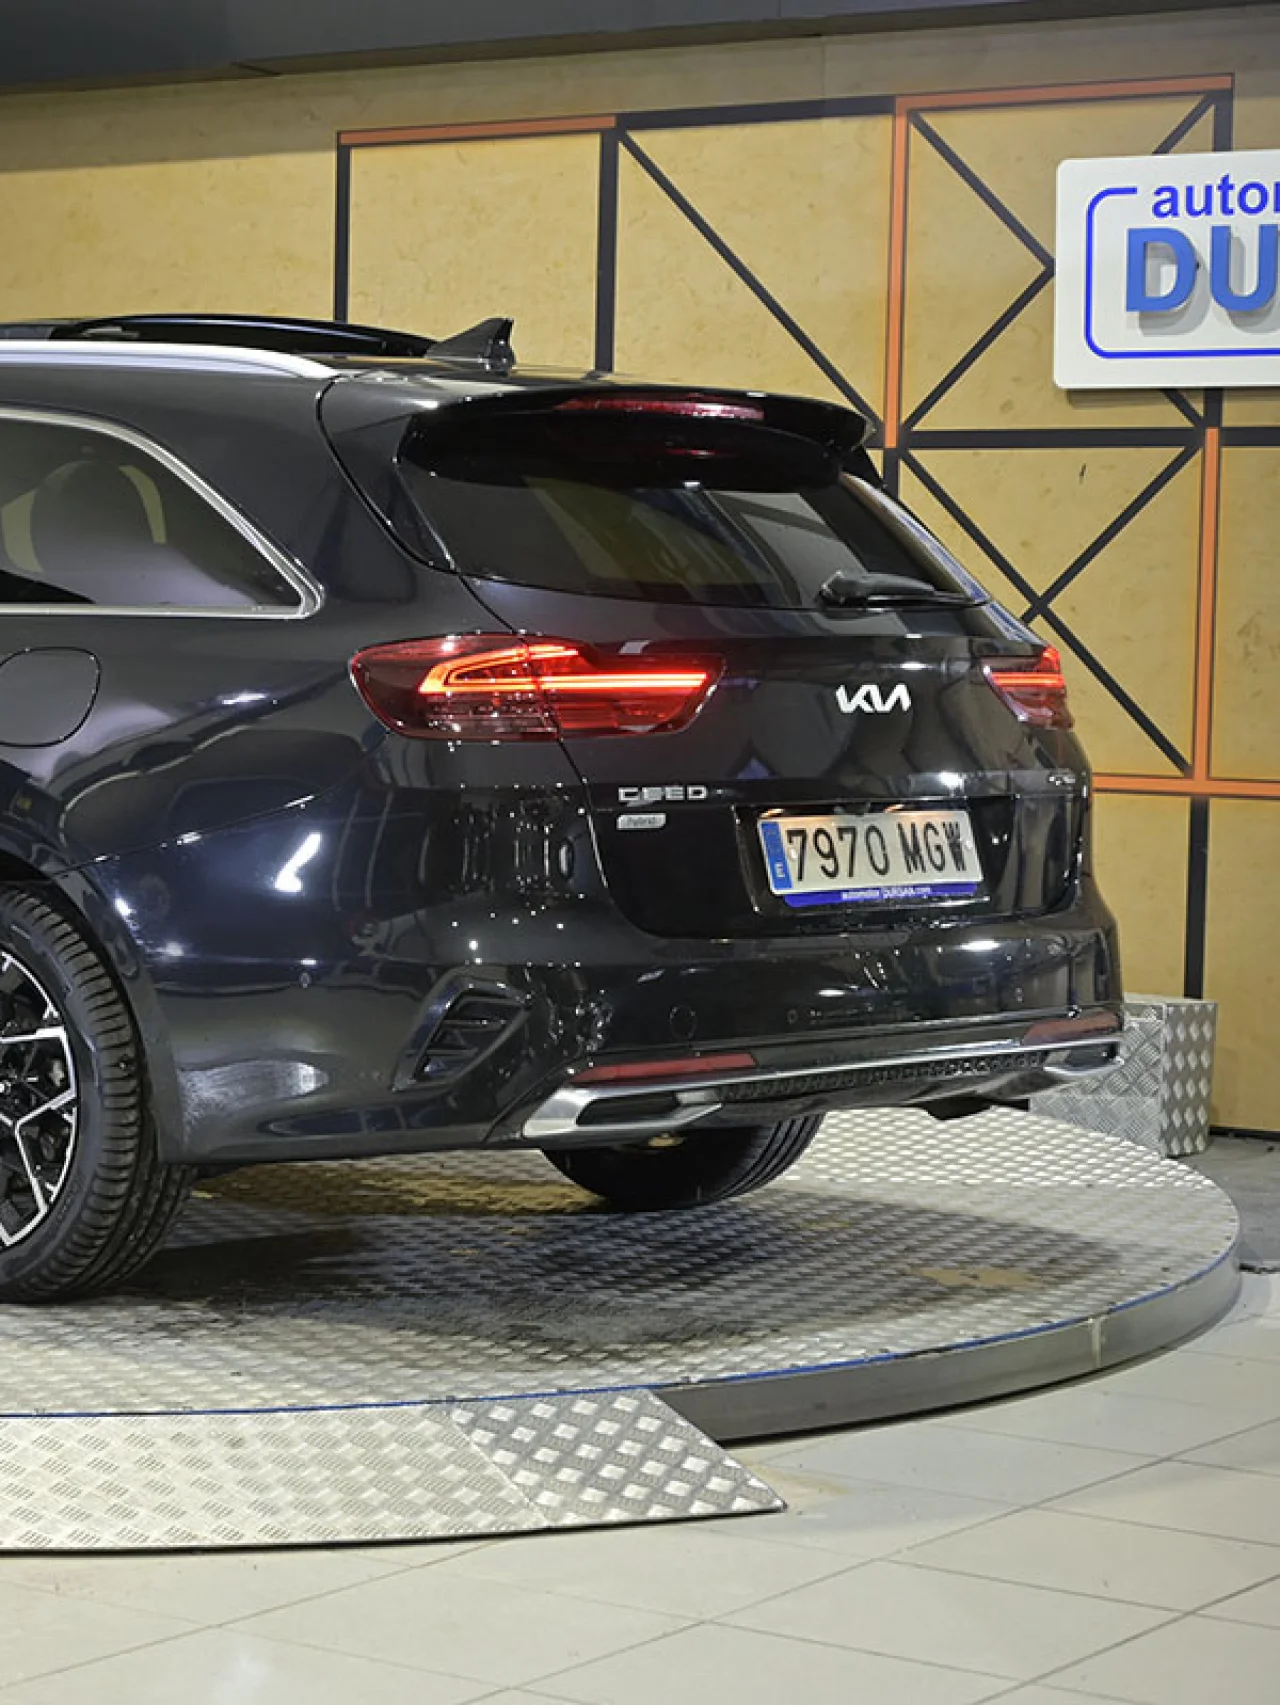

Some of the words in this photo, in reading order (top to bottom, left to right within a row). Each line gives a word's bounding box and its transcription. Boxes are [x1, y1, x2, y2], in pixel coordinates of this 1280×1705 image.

[1151, 172, 1280, 218] auto
[786, 824, 890, 882] 7970
[897, 820, 968, 875] MGW
